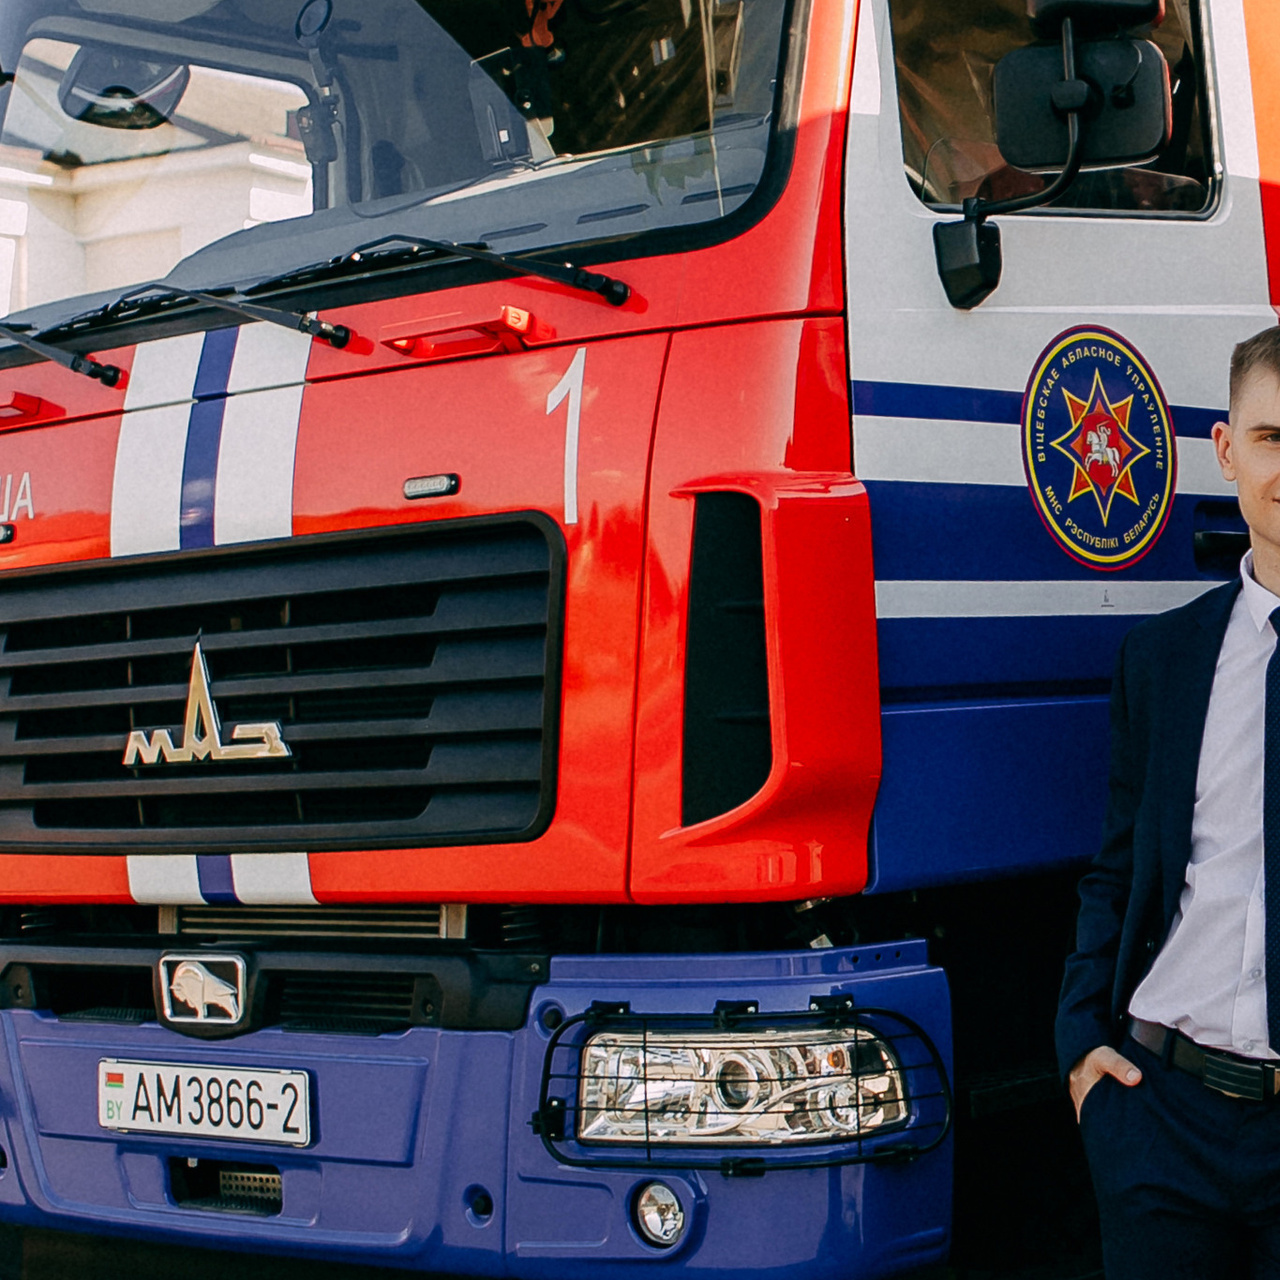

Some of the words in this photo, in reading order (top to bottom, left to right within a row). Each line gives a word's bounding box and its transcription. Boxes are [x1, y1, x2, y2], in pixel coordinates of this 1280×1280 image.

[545, 347, 587, 524] 1
[1036, 368, 1060, 462] ВІЦЕБСКАЕ
[1061, 346, 1121, 368] АБЛАСНОЕ
[1045, 485, 1063, 515] МНС
[1065, 518, 1119, 549] РЭСПУБЛІКІ
[1123, 493, 1160, 544] БЕЛАРУСЬ
[106, 1100, 123, 1120] BY
